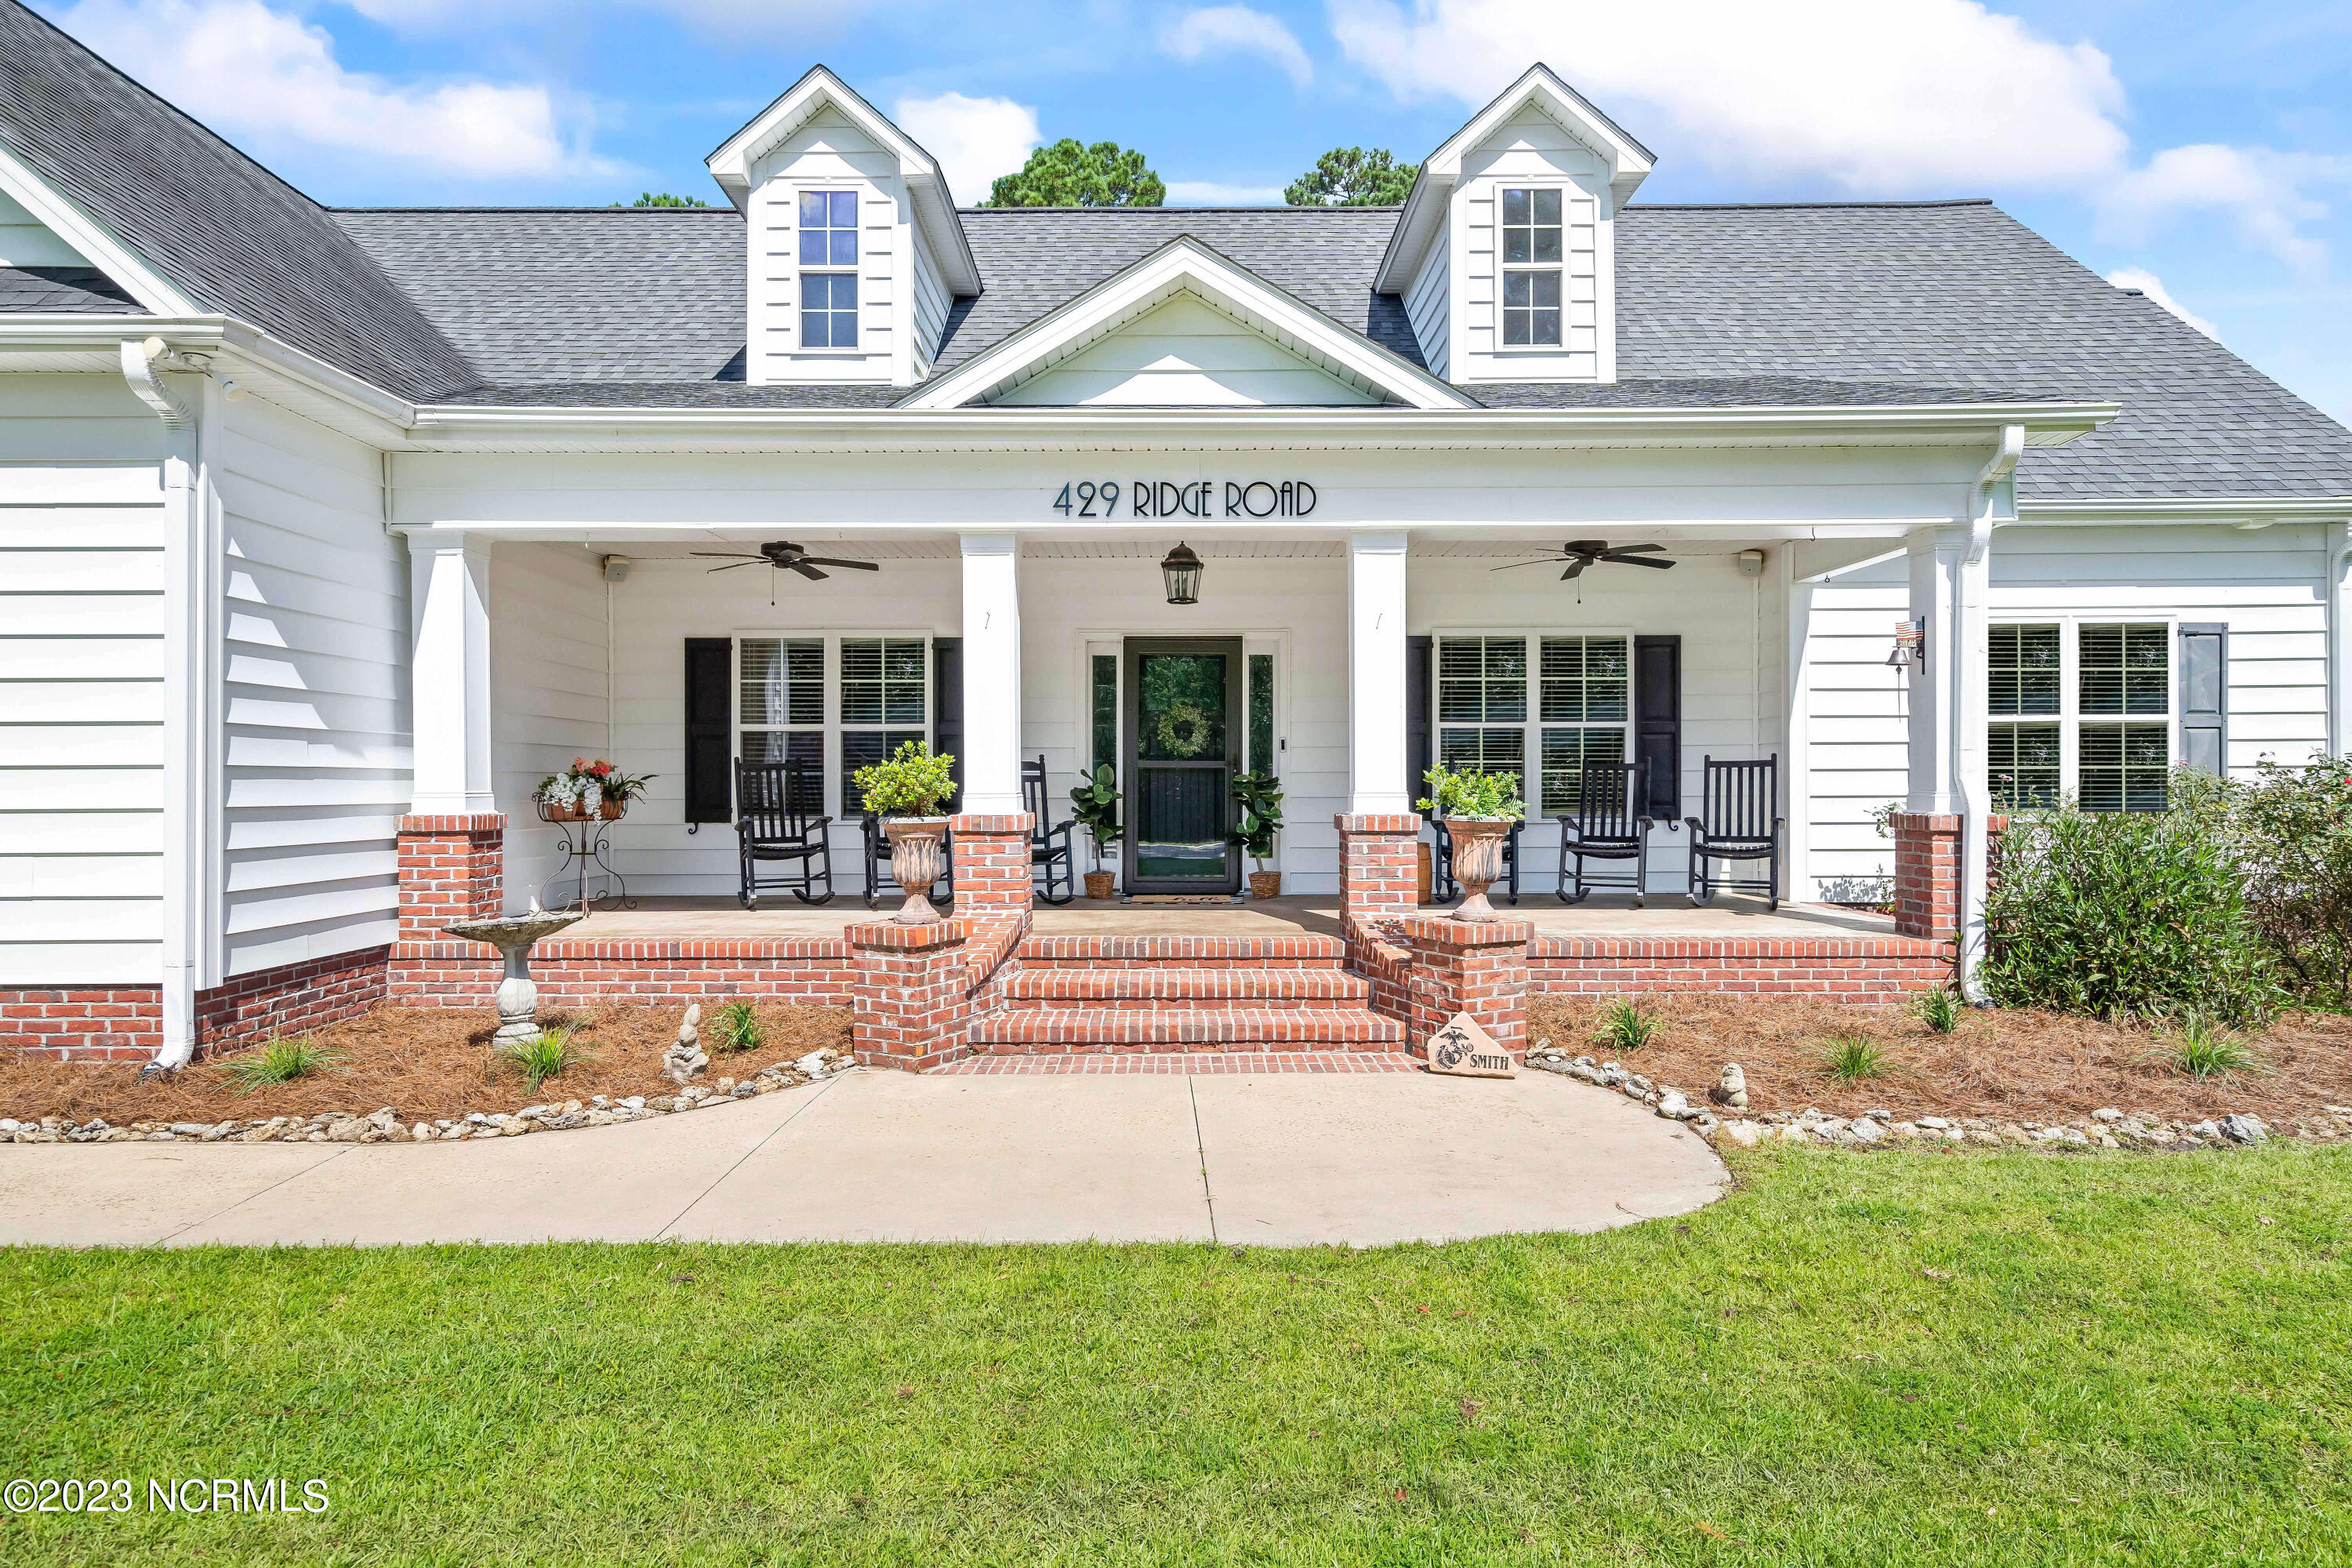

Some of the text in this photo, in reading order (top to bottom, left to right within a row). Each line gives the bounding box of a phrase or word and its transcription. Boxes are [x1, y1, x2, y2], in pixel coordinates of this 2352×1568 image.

[1052, 481, 1317, 517] 429 RIDGE ROAD
[1469, 1054, 1509, 1070] SMITH
